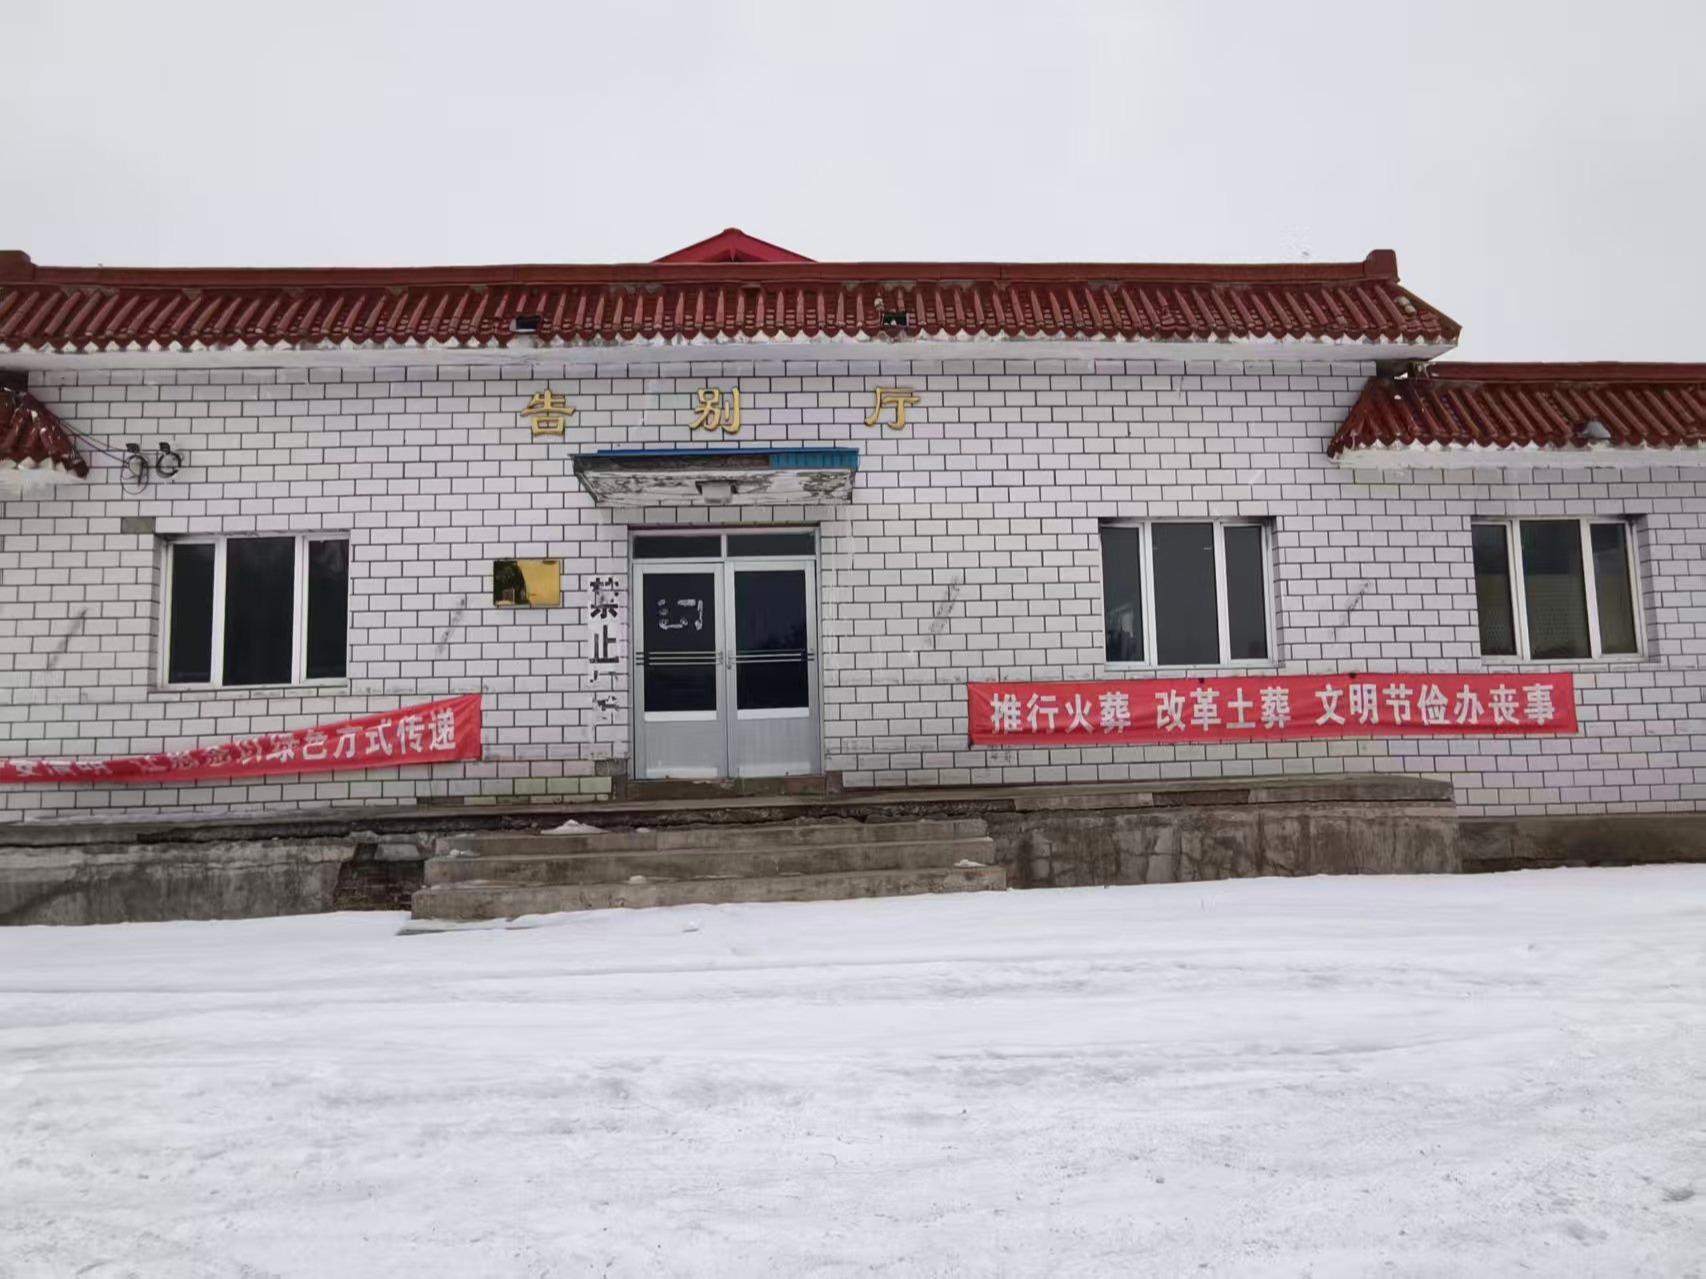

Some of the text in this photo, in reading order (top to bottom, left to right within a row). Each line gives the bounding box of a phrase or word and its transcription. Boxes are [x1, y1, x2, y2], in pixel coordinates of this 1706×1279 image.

[520, 386, 921, 436] 告别厅
[589, 577, 620, 712] 禁止
[990, 683, 1555, 735] 推行火葬 改革土葬 文明节俭办丧事
